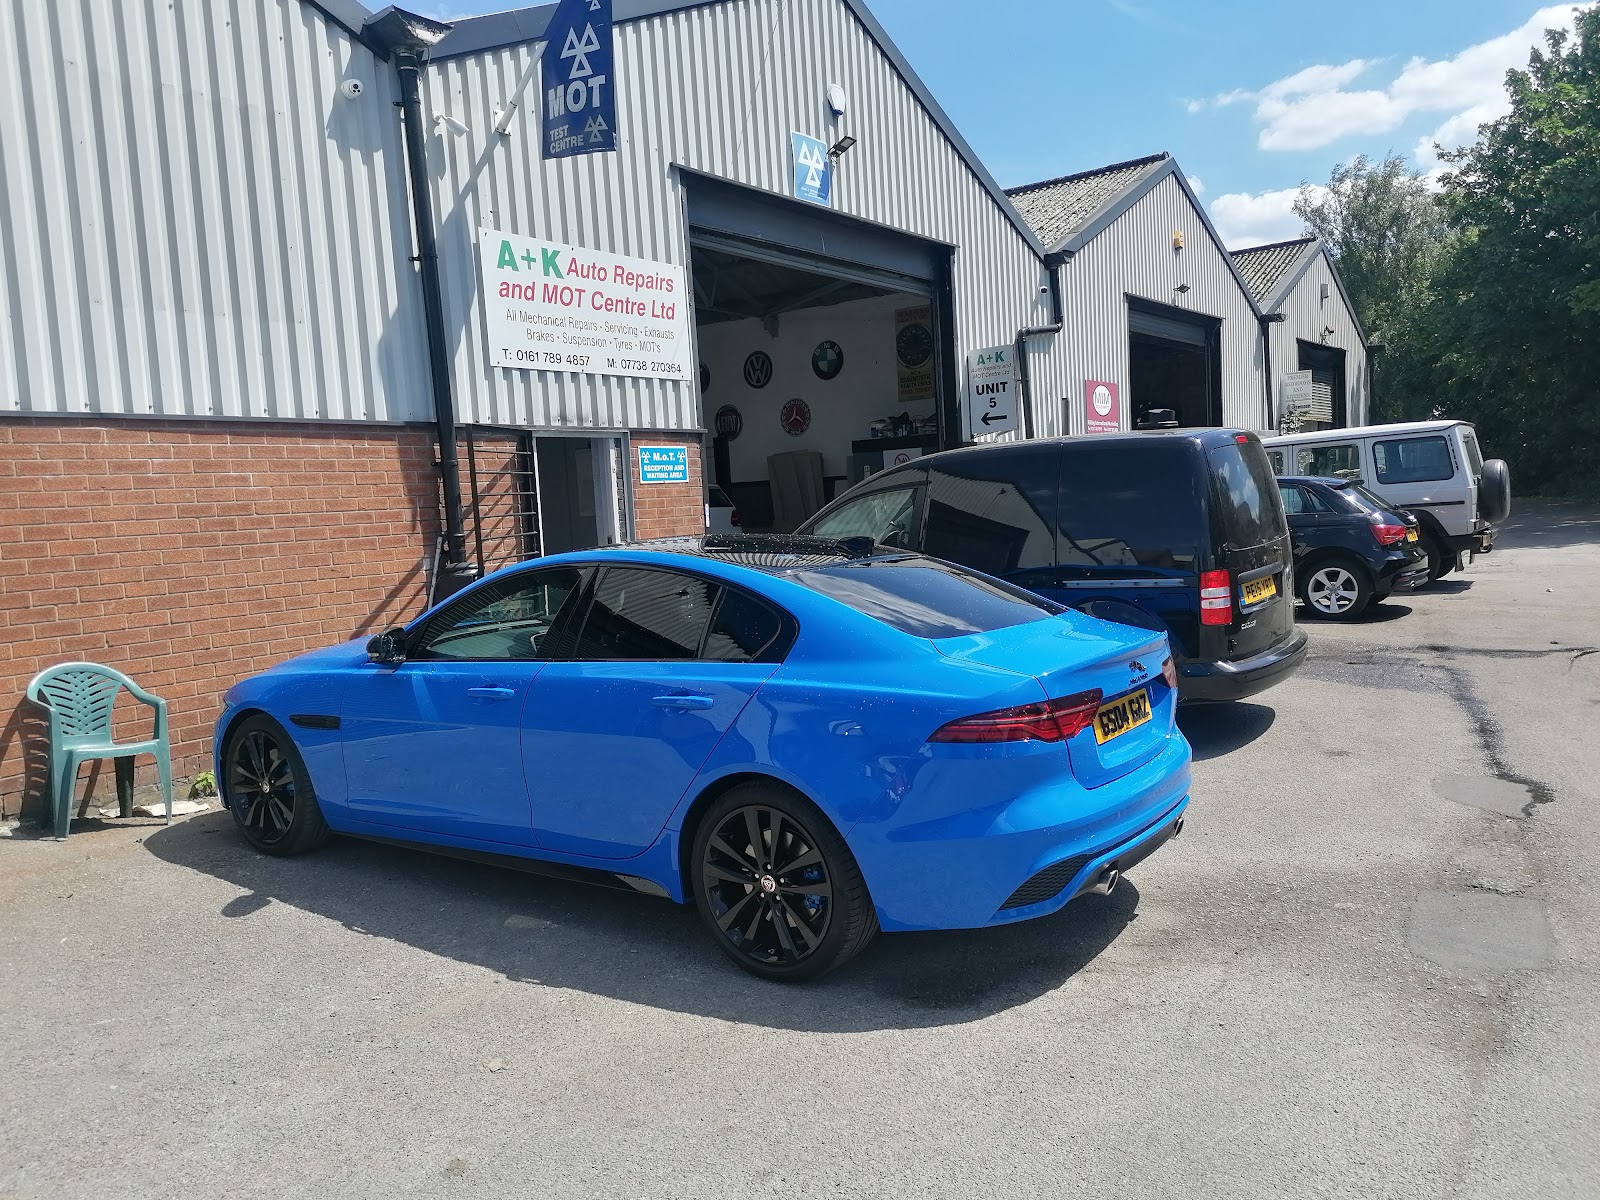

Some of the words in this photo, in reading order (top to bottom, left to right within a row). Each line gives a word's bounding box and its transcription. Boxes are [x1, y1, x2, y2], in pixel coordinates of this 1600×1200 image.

[547, 74, 606, 120] MOT
[549, 124, 569, 142] TEST
[549, 134, 585, 154] CENTRE
[496, 239, 565, 279] A+K
[566, 257, 608, 282] Auto
[613, 265, 674, 293] Repairs
[499, 281, 536, 302] and
[542, 283, 586, 308] MOT
[591, 291, 646, 317] Centre
[651, 300, 676, 321] Ltd
[506, 308, 518, 322] All
[519, 310, 567, 328] Mechanical
[569, 316, 598, 332] Repairs
[604, 321, 639, 337] Servicing
[644, 326, 675, 340] Exhausts
[526, 328, 555, 343] Brakes
[562, 332, 607, 348] Suspension
[614, 337, 633, 351] Tyres
[516, 349, 540, 363] 0161
[543, 351, 562, 364] 789
[566, 353, 590, 366] 4857
[815, 342, 840, 356] BMW
[620, 359, 648, 371] 07738
[651, 361, 682, 374] 270364
[977, 350, 1005, 366] A+K
[976, 381, 1008, 396] UNIT
[989, 397, 997, 408] 5
[721, 415, 736, 432] FIAT
